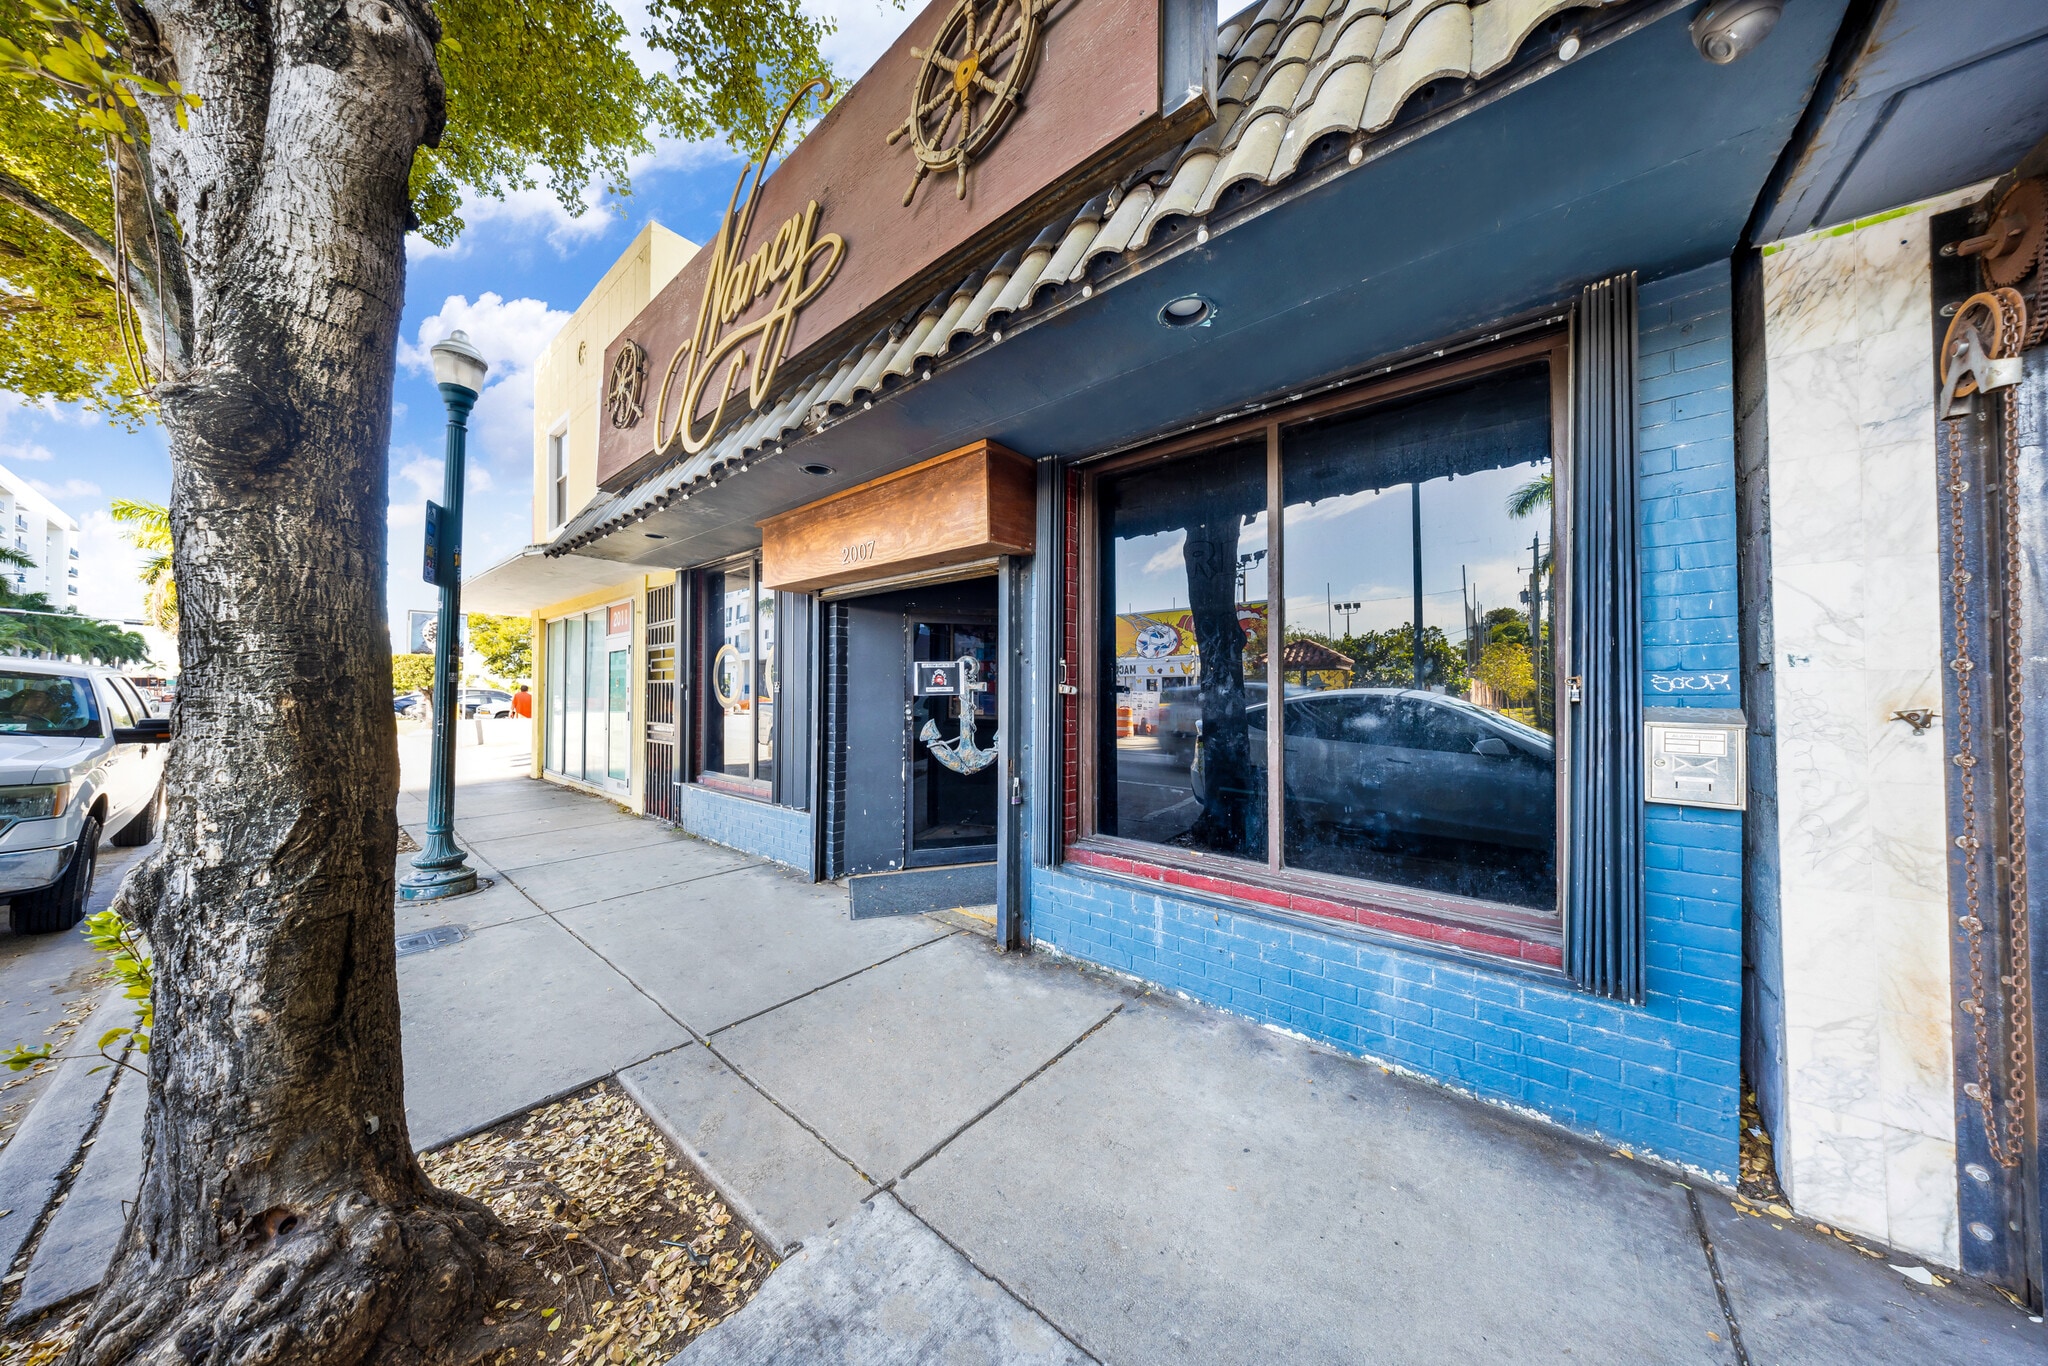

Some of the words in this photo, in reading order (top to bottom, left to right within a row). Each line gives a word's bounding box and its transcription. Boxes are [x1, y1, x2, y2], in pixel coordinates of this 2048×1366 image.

[653, 76, 846, 456] Nancy
[841, 540, 876, 566] 2007
[613, 608, 628, 628] 2011
